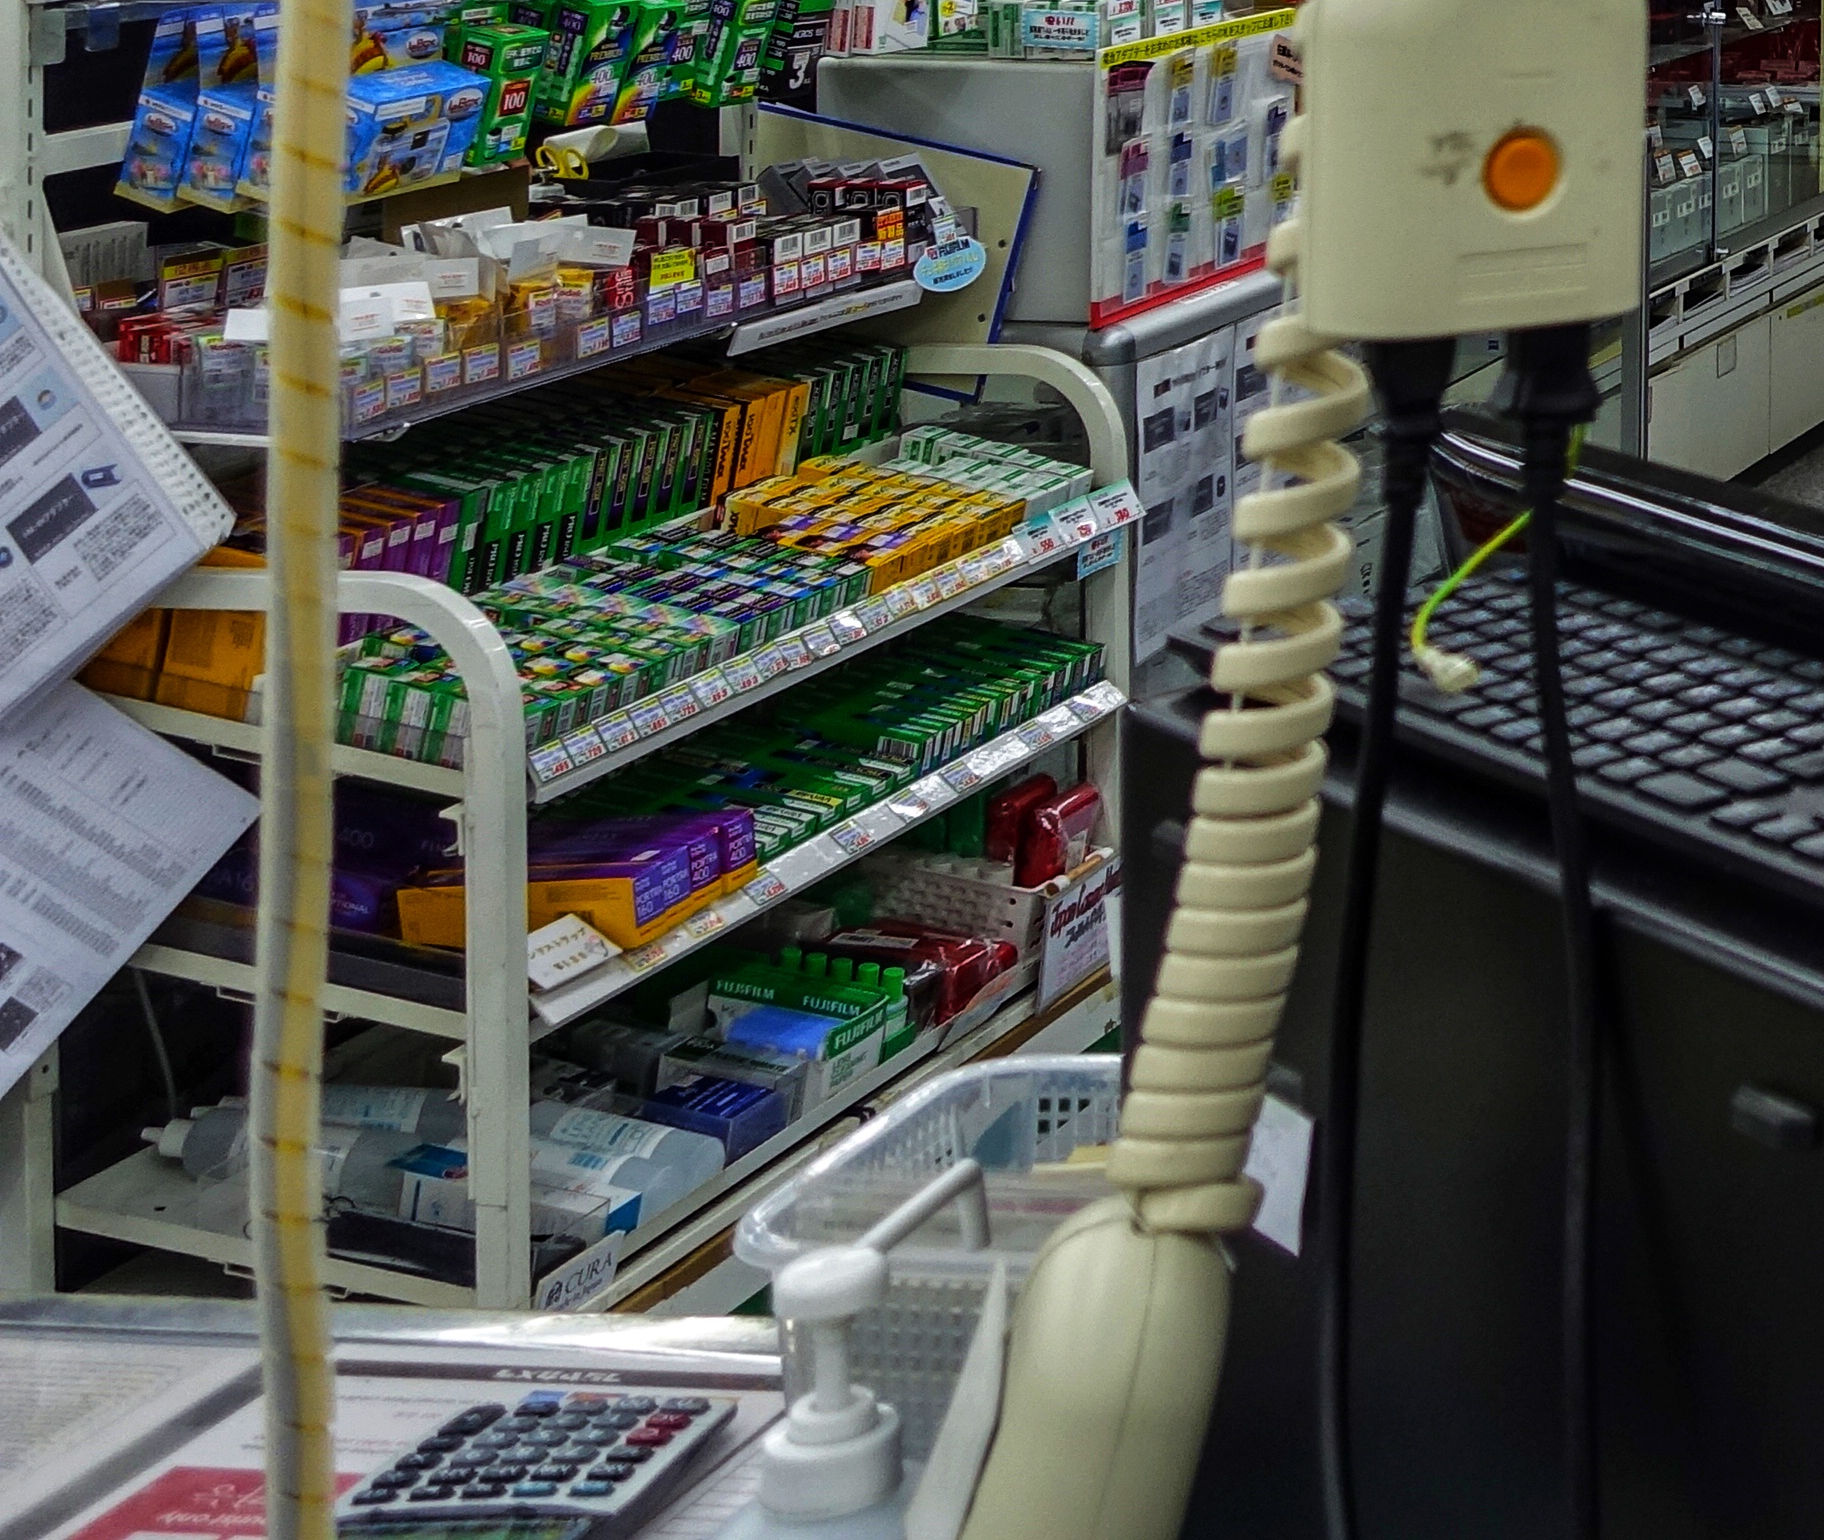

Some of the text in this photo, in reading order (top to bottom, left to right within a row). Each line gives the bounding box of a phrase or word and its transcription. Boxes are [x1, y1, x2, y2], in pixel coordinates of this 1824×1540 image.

[716, 978, 774, 1000] FUJIFILM
[802, 995, 860, 1016] FUJIFILM
[834, 1009, 884, 1050] FUJIFILM
